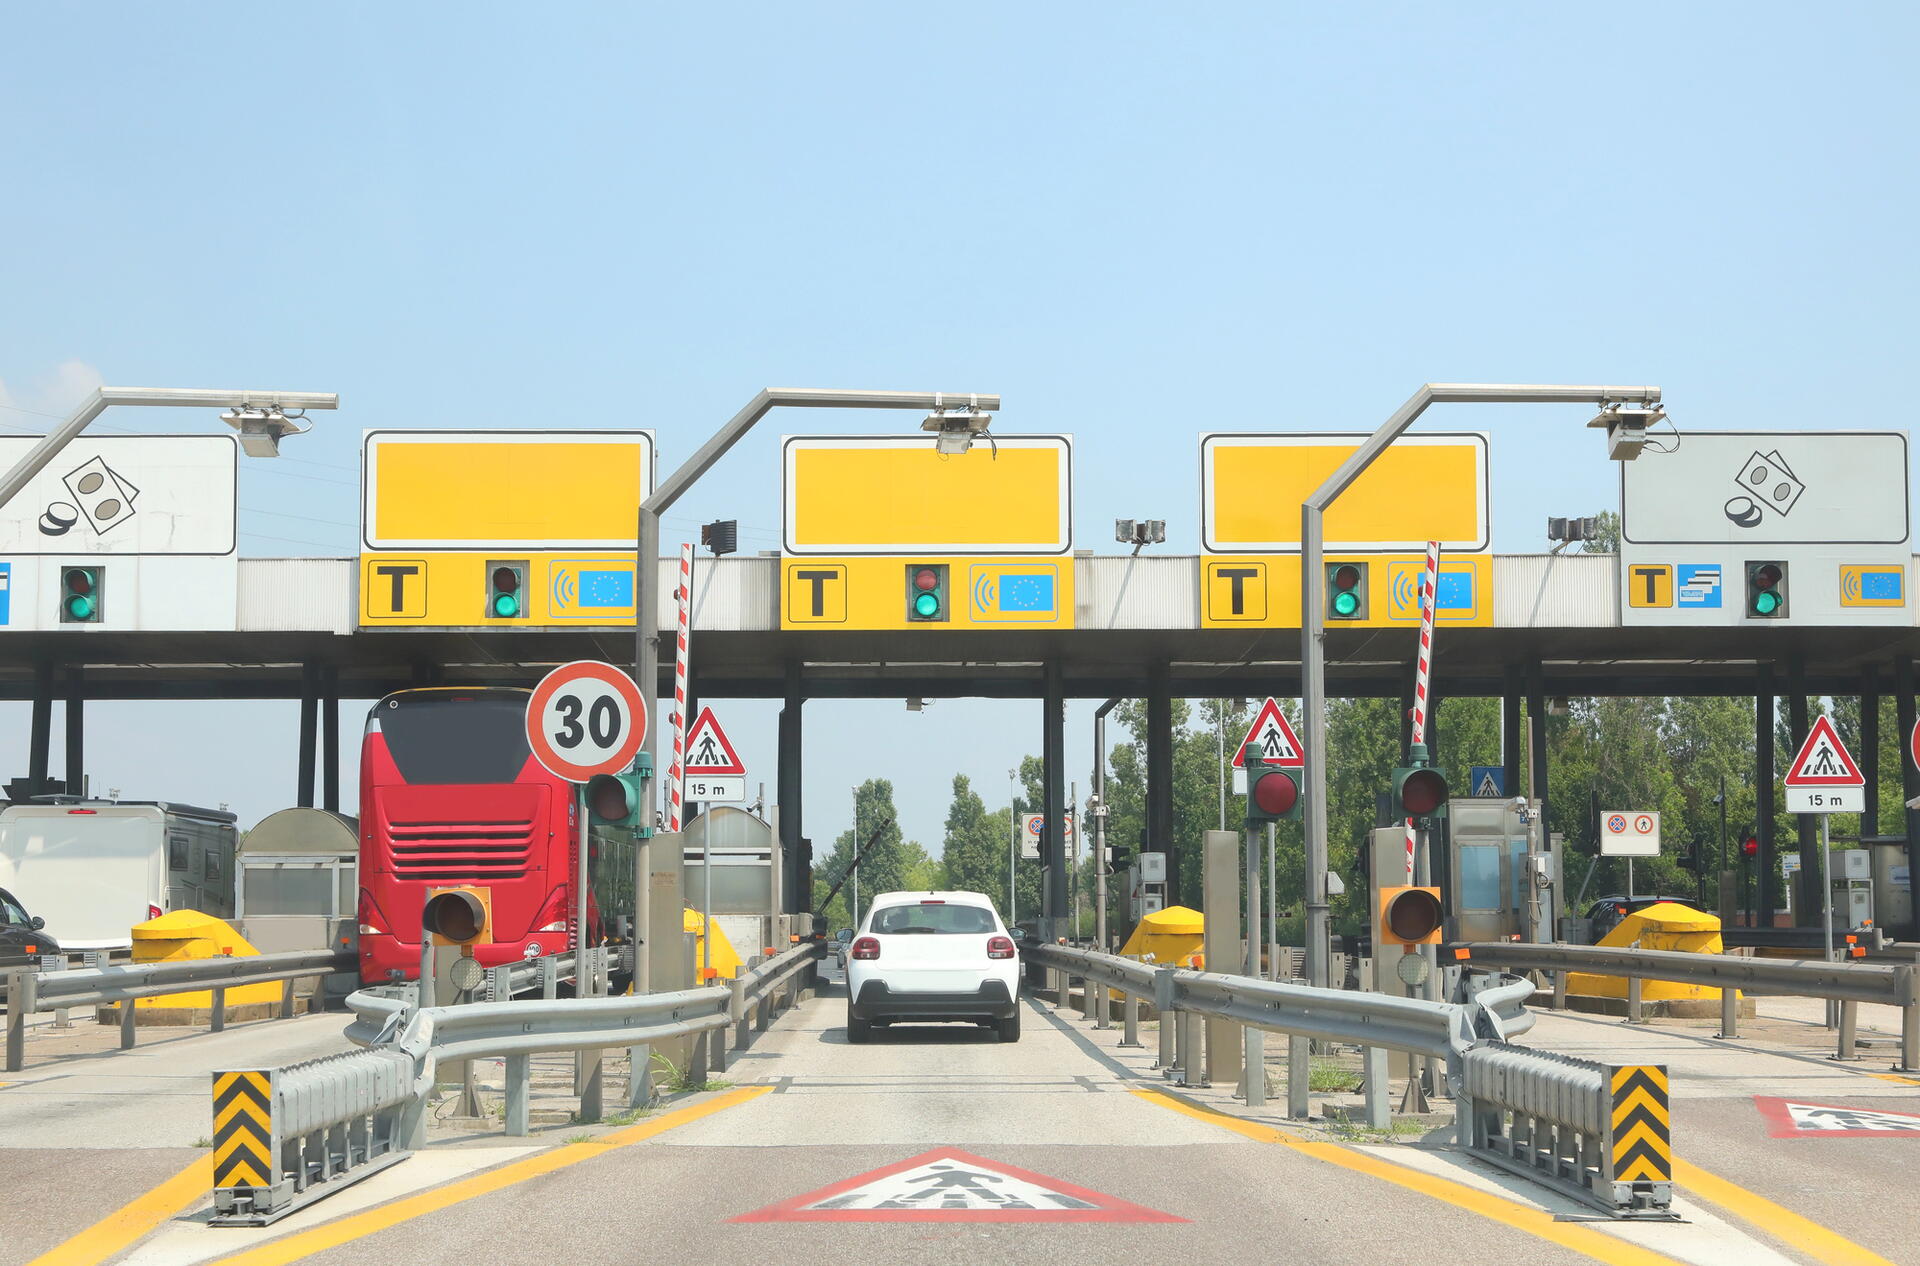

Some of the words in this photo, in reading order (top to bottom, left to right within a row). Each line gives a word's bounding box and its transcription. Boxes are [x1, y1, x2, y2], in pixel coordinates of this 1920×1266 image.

[377, 566, 419, 612] T
[797, 571, 838, 616] T
[1217, 569, 1258, 614] T
[1635, 568, 1666, 603] T
[555, 695, 622, 749] 30
[692, 783, 706, 795] 15
[713, 786, 725, 795] m
[1808, 794, 1823, 806] 15
[1830, 797, 1842, 806] m
